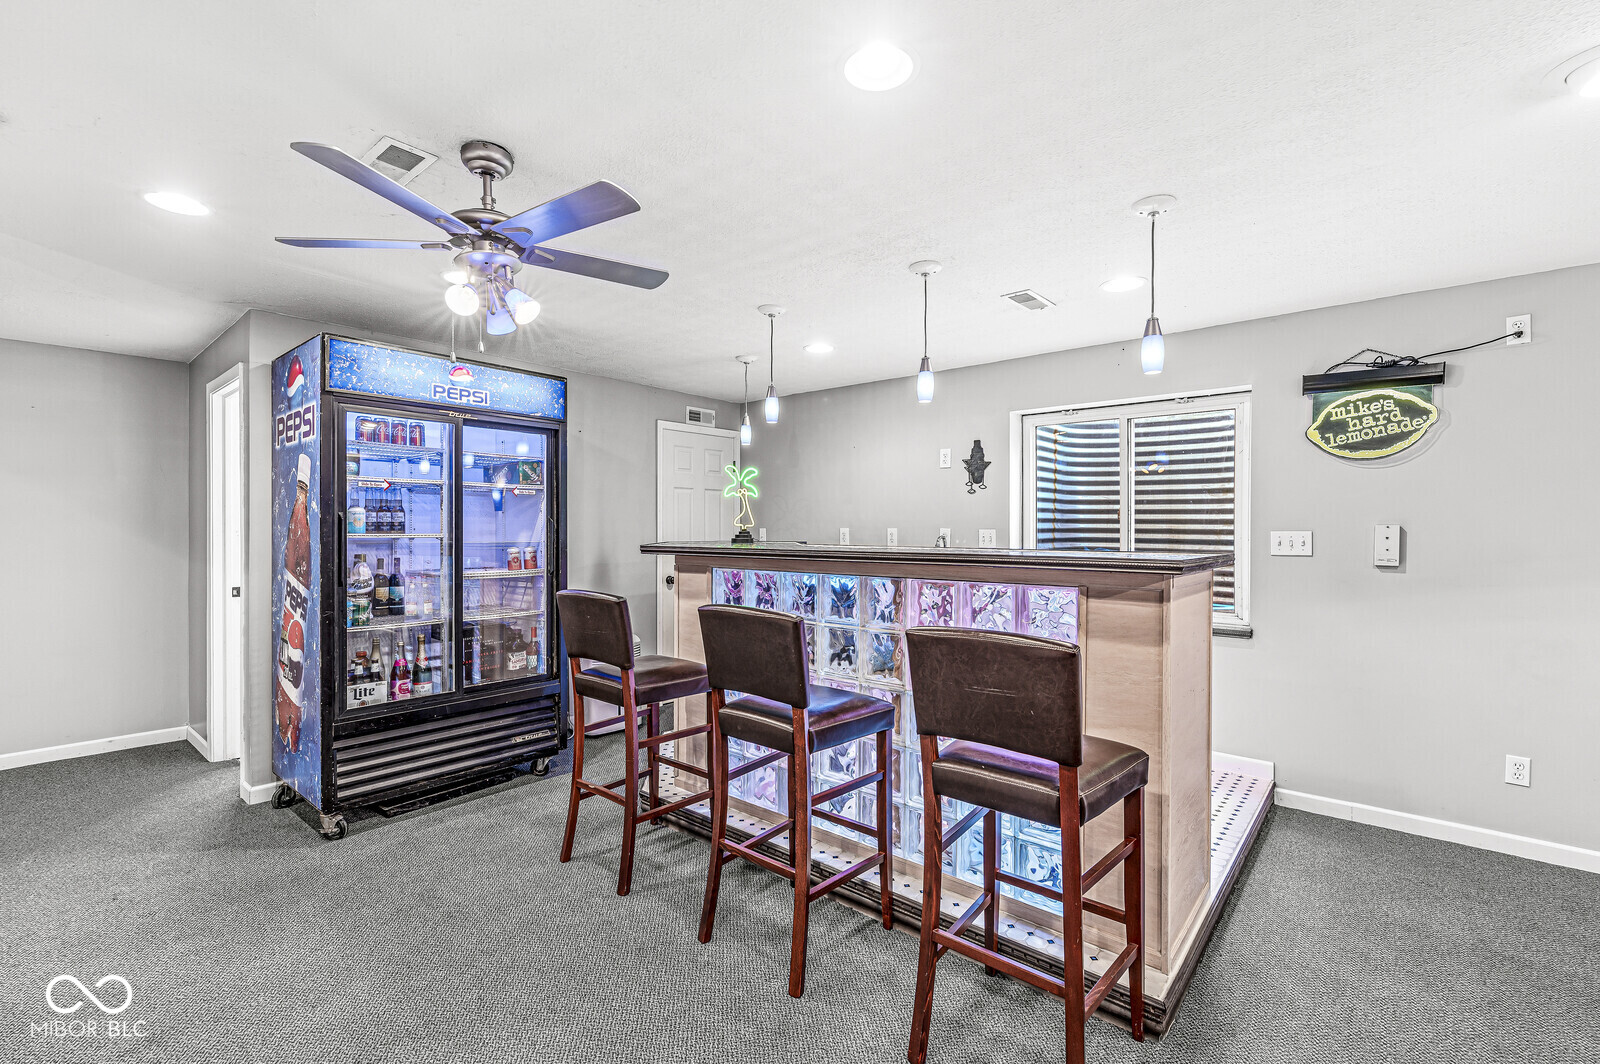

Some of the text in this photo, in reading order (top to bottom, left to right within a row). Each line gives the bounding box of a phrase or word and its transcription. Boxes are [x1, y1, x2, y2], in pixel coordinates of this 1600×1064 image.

[432, 384, 489, 405] PEPSI
[1330, 399, 1395, 421] mike's
[1346, 407, 1403, 431] hard
[276, 404, 315, 447] PEPSI
[1325, 417, 1427, 448] lemonade
[285, 579, 309, 623] PEPS
[353, 687, 375, 700] Lite
